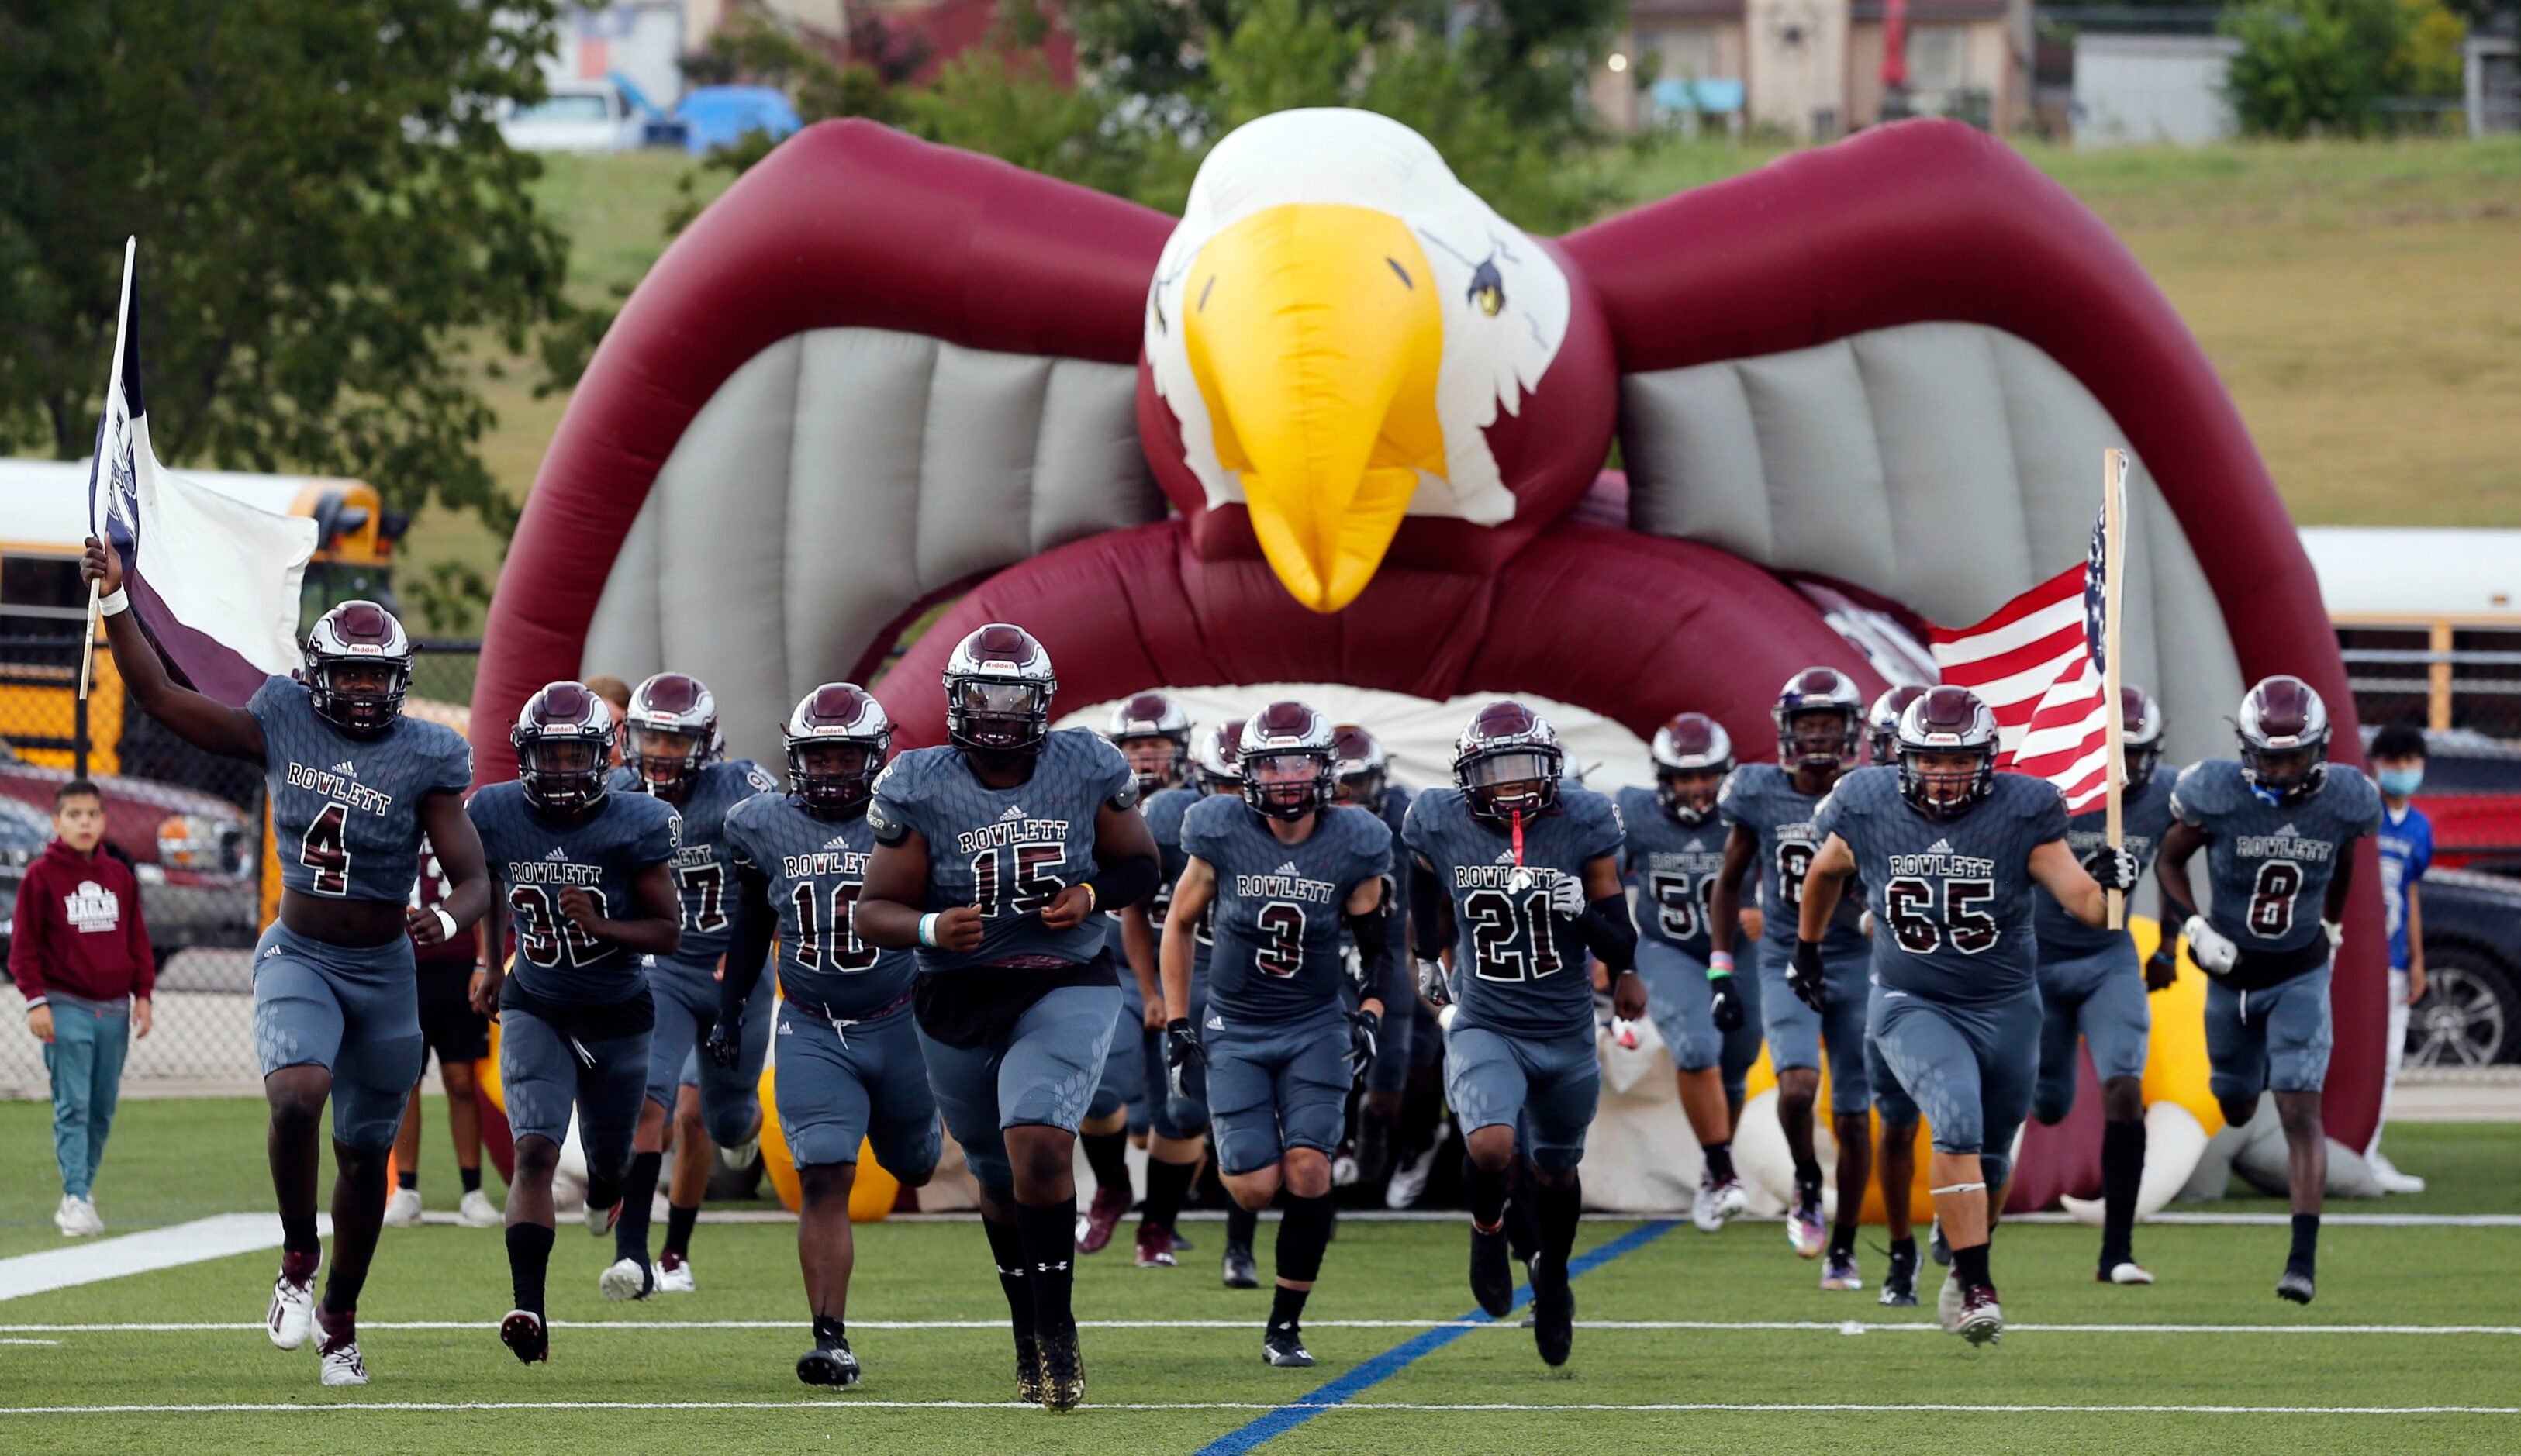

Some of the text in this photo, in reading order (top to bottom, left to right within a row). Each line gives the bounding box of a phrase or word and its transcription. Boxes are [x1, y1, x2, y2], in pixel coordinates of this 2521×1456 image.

[351, 645, 379, 654] Riddell
[985, 661, 1015, 670] Riddell
[546, 724, 574, 733] Riddell
[816, 726, 844, 735] Riddell
[331, 765, 357, 778] adidas
[288, 761, 392, 816] ROWLETT
[999, 812, 1027, 822] adidas
[300, 801, 351, 896] 4
[958, 819, 1069, 854] ROWLETT
[2236, 836, 2333, 862] ROWLETT
[509, 861, 603, 885] ROWLETT
[784, 851, 872, 878] ROWLET
[1454, 865, 1559, 889] ROWLTT
[1888, 854, 1994, 878] ROWLETT
[969, 841, 1066, 919] 15
[1236, 875, 1335, 904] ROWLETT
[1649, 870, 1714, 940] 5
[2246, 859, 2304, 940] 8
[509, 884, 619, 968] 32
[792, 881, 880, 973] 10
[1885, 876, 2001, 954] 65
[1255, 900, 1307, 979] 3
[1463, 889, 1563, 982] 21
